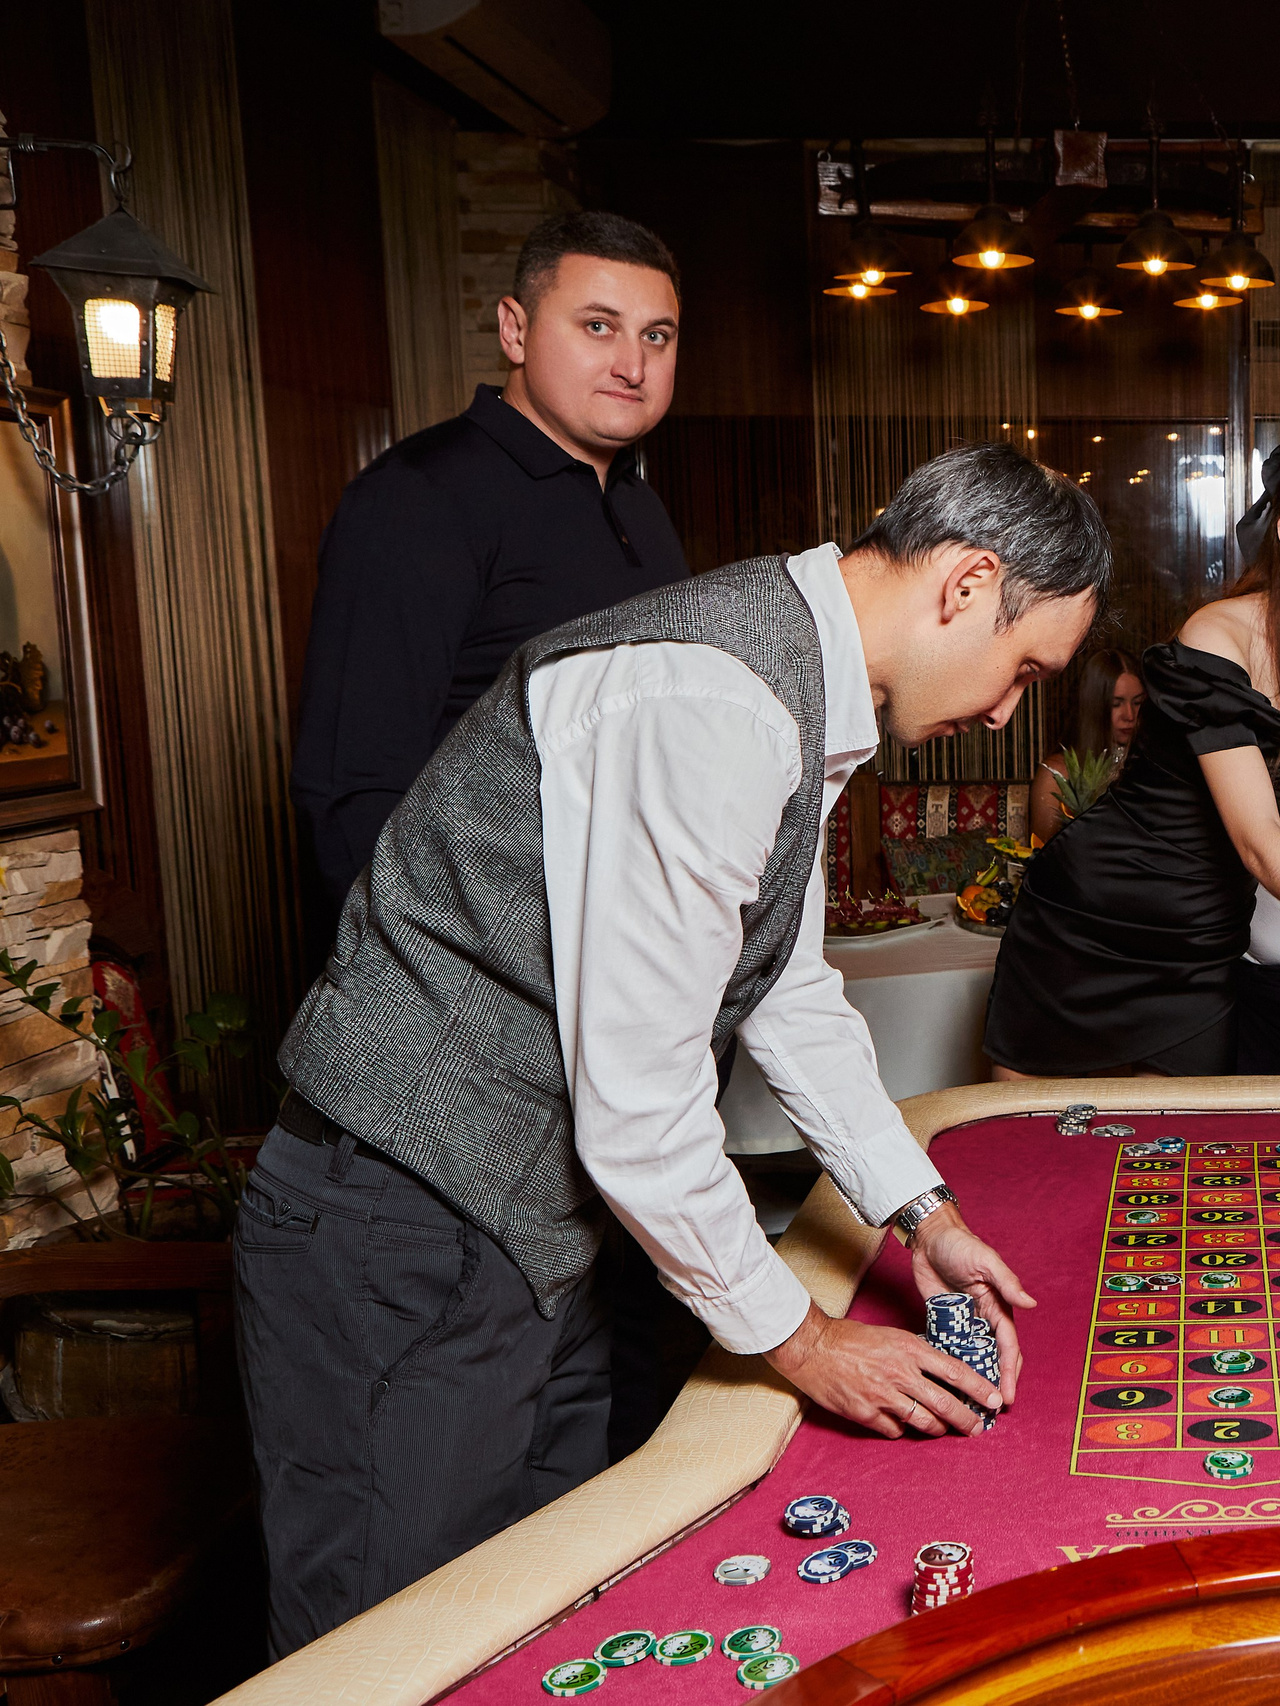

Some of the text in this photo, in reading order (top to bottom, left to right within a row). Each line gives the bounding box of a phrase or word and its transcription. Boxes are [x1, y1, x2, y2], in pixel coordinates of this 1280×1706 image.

[1132, 1161, 1171, 1170] 36
[1203, 1160, 1241, 1169] 35
[1131, 1177, 1170, 1187] 33
[1203, 1176, 1241, 1186] 32
[1127, 1194, 1169, 1204] 30
[1201, 1193, 1243, 1203] 29
[1201, 1211, 1244, 1222] 26
[1124, 1234, 1168, 1246] 24
[1202, 1232, 1245, 1244] 23
[1124, 1255, 1165, 1268] 21
[1201, 1253, 1247, 1266] 20
[1117, 1302, 1157, 1316] 15
[1201, 1300, 1248, 1314] 14
[1113, 1330, 1159, 1345] 12
[1208, 1329, 1247, 1344] 11
[1115, 1422, 1143, 1441] 3
[1213, 1421, 1241, 1440] 2
[676, 1639, 704, 1655] 25
[565, 1671, 594, 1686] 25
